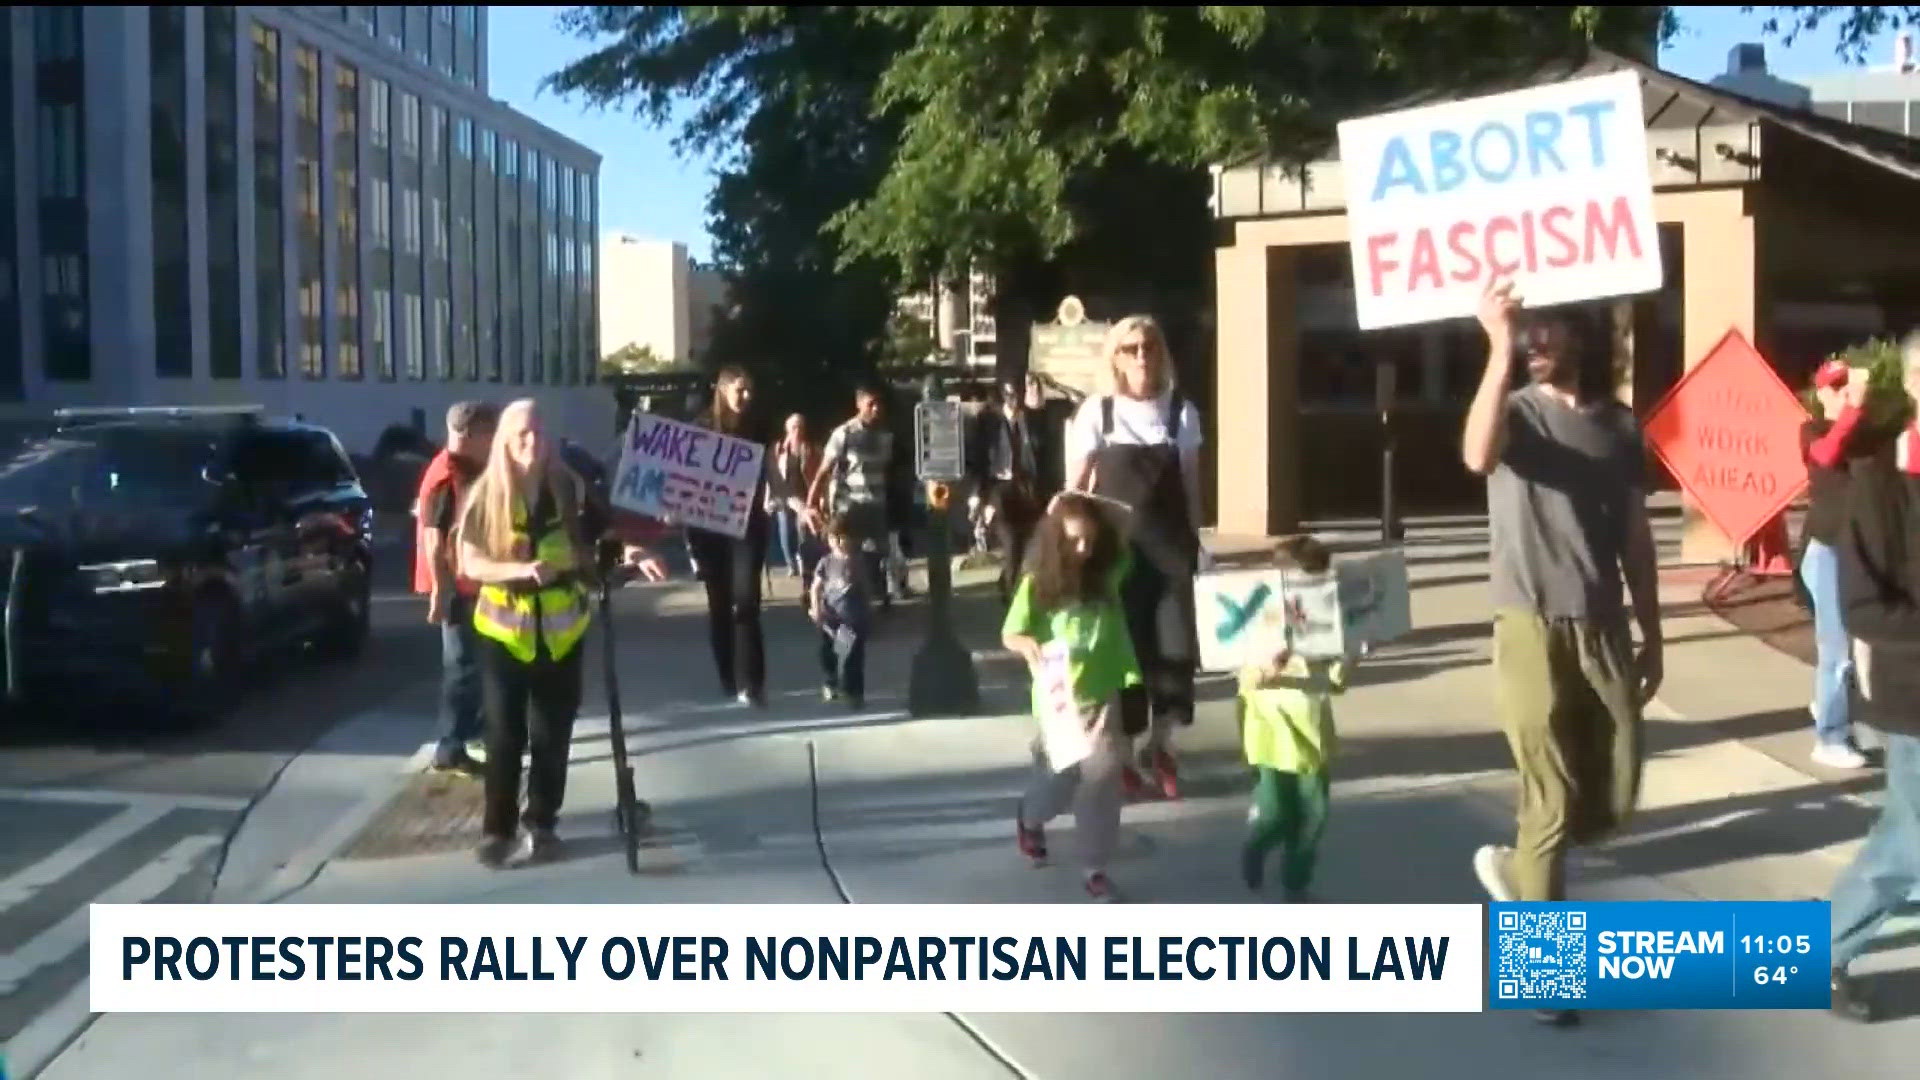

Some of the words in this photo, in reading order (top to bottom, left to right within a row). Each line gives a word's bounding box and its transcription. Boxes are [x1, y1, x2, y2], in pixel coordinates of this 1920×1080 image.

[1371, 100, 1616, 202] ABORT
[1367, 196, 1643, 297] FASCISM
[632, 415, 708, 469] WAKE
[712, 437, 754, 477] UP
[1698, 425, 1769, 456] WORK
[1692, 463, 1777, 496] AHEAD
